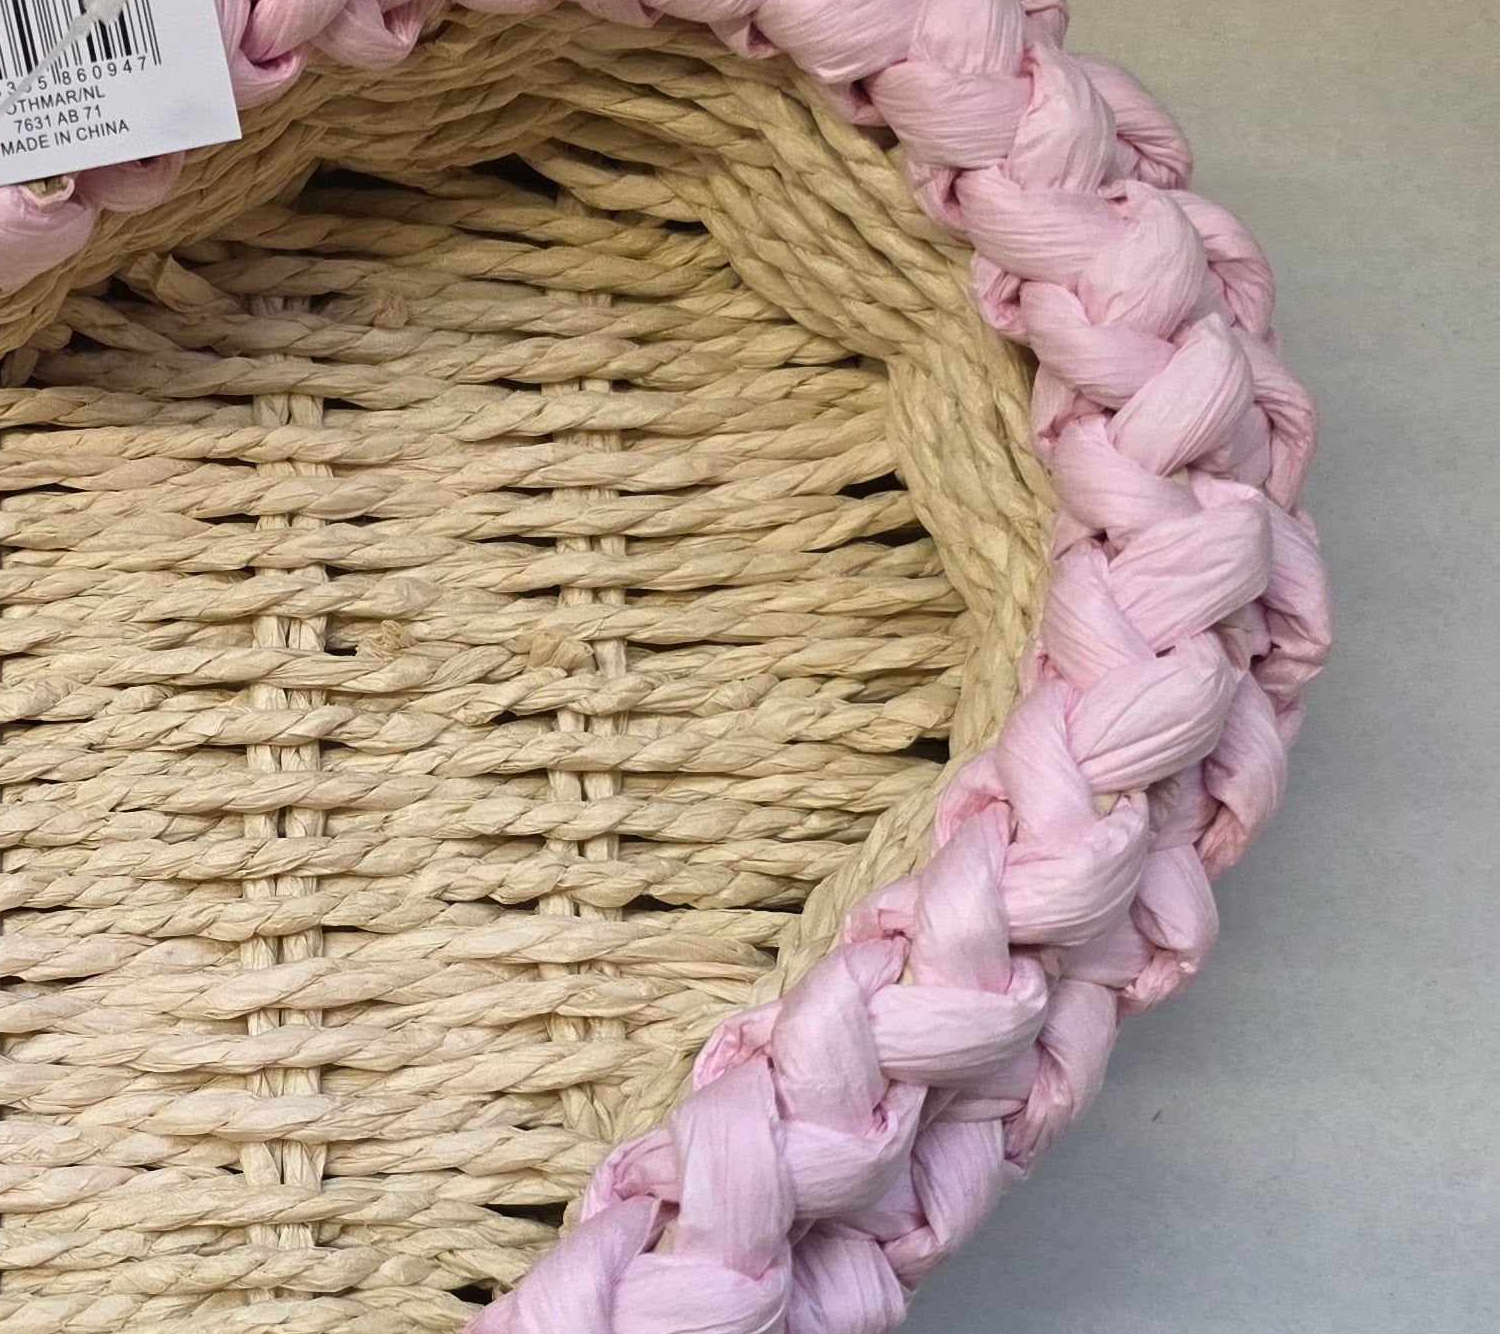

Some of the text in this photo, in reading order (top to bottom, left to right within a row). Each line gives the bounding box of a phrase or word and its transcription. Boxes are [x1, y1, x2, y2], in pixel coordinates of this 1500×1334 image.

[14, 104, 102, 133] 7631 AB 71
[0, 119, 130, 157] MADE IN CHINA
